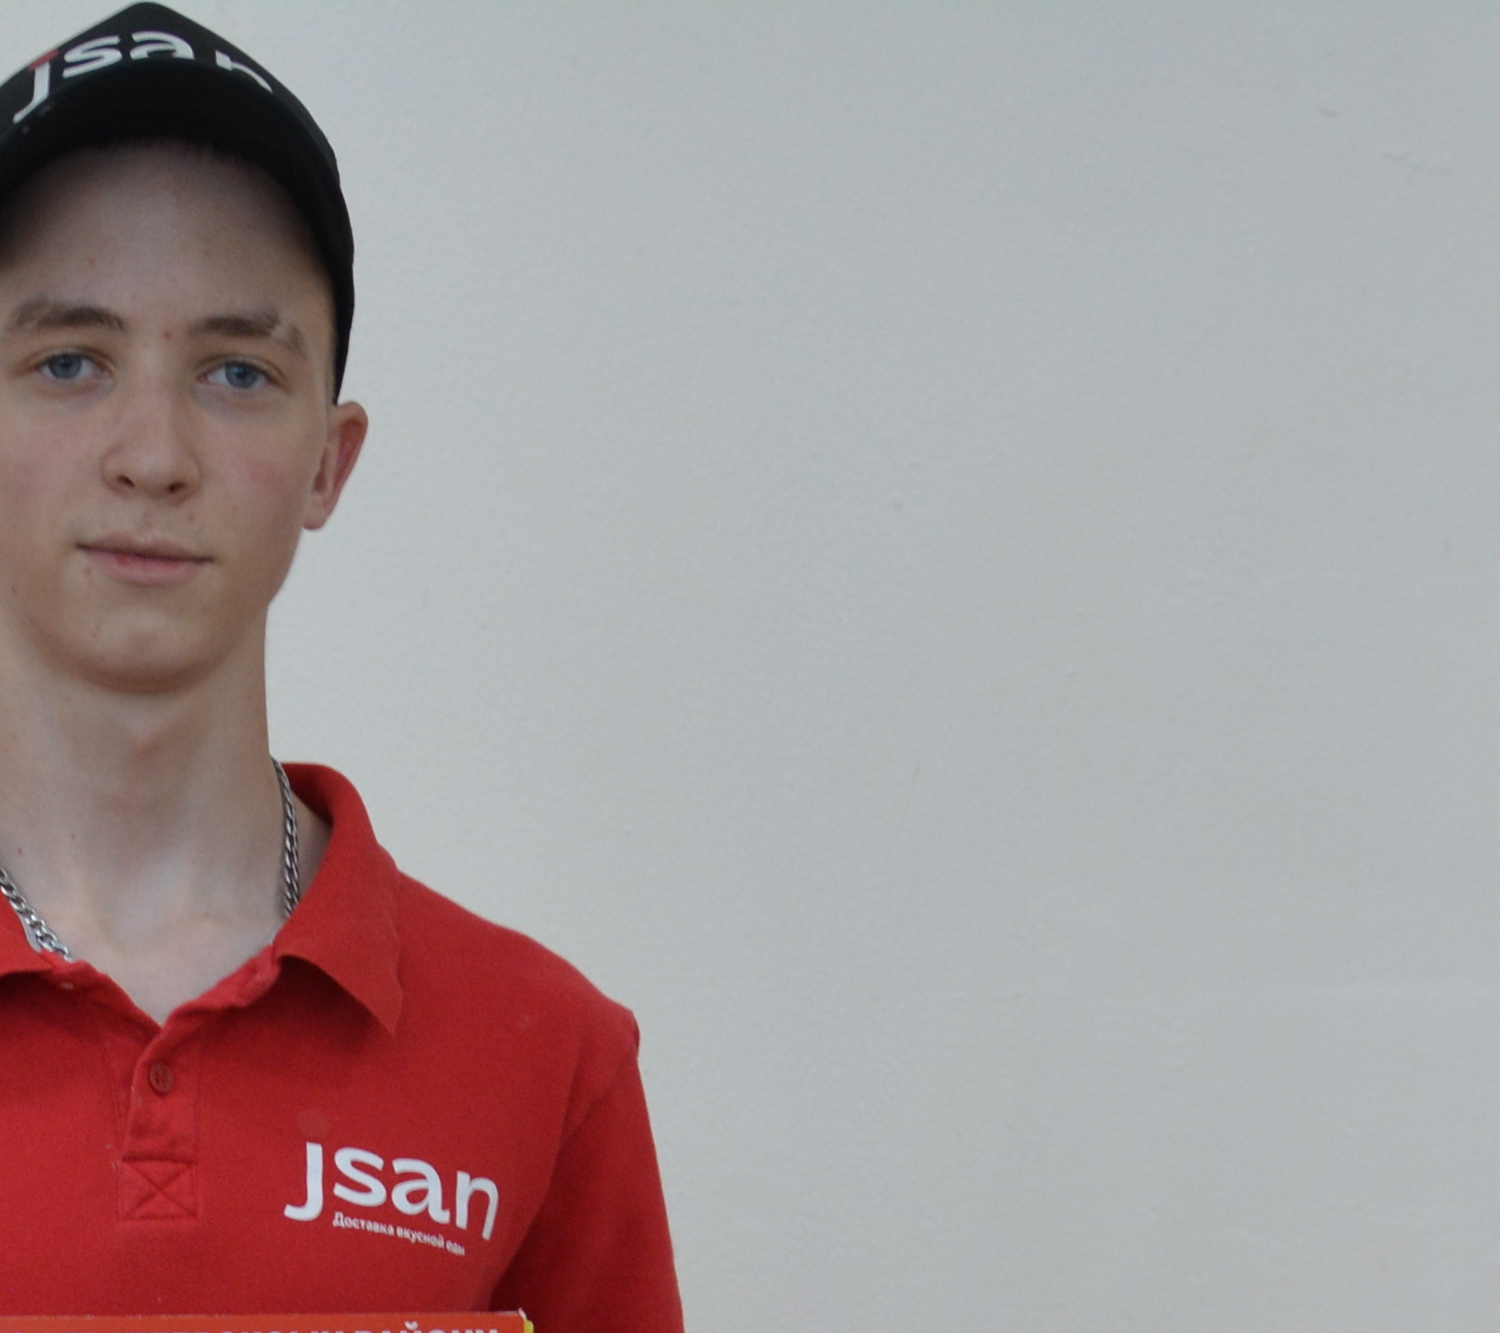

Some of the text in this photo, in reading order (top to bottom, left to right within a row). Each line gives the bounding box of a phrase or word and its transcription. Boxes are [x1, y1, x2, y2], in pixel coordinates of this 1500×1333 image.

[284, 1142, 499, 1240] jsan
[332, 1211, 395, 1236] Доставка
[396, 1226, 445, 1249] вкусной
